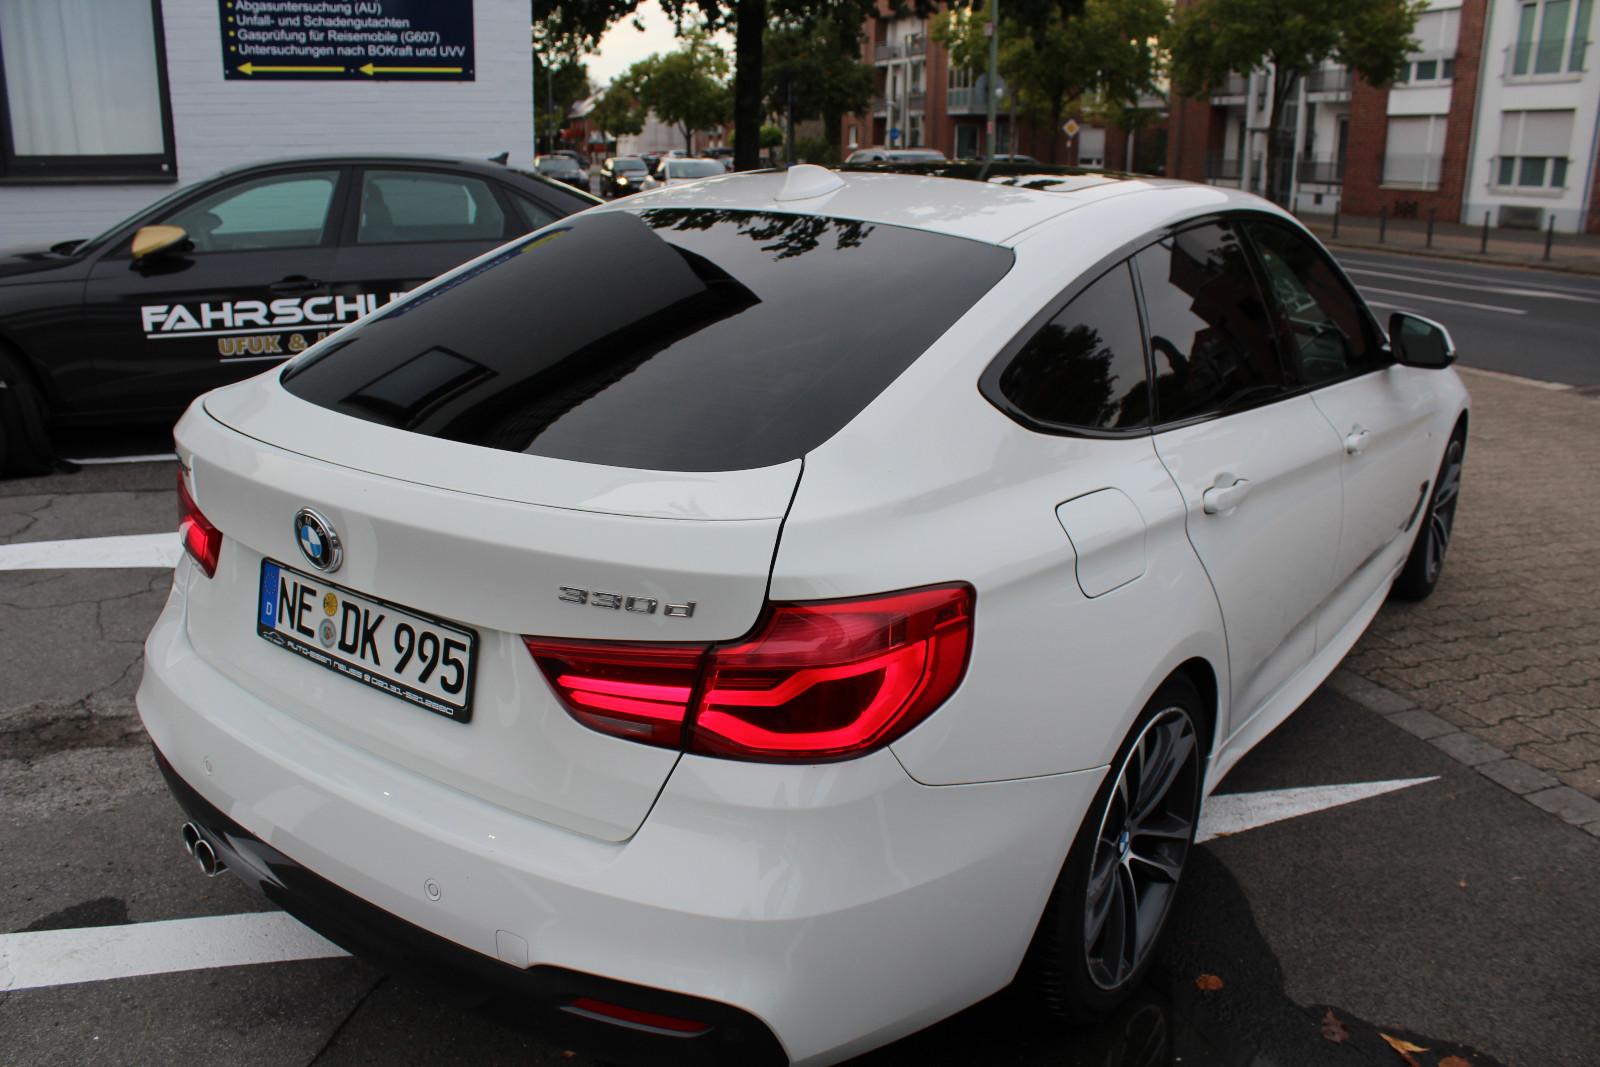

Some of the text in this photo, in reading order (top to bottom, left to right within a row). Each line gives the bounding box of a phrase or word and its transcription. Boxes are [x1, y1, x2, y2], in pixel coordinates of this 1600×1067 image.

[235, 1, 382, 16] Abgasuntersuchung (AU)
[236, 15, 410, 29] Unfall- und Schadengutachten
[237, 28, 440, 44] Gasprüfung für Reisemobile (G607)
[239, 44, 465, 58] Untersuchungen nach BOKraft und UVV
[218, 335, 283, 356] UFUK
[288, 332, 308, 352] &
[266, 601, 273, 616] D
[278, 576, 467, 695] NE DK 995
